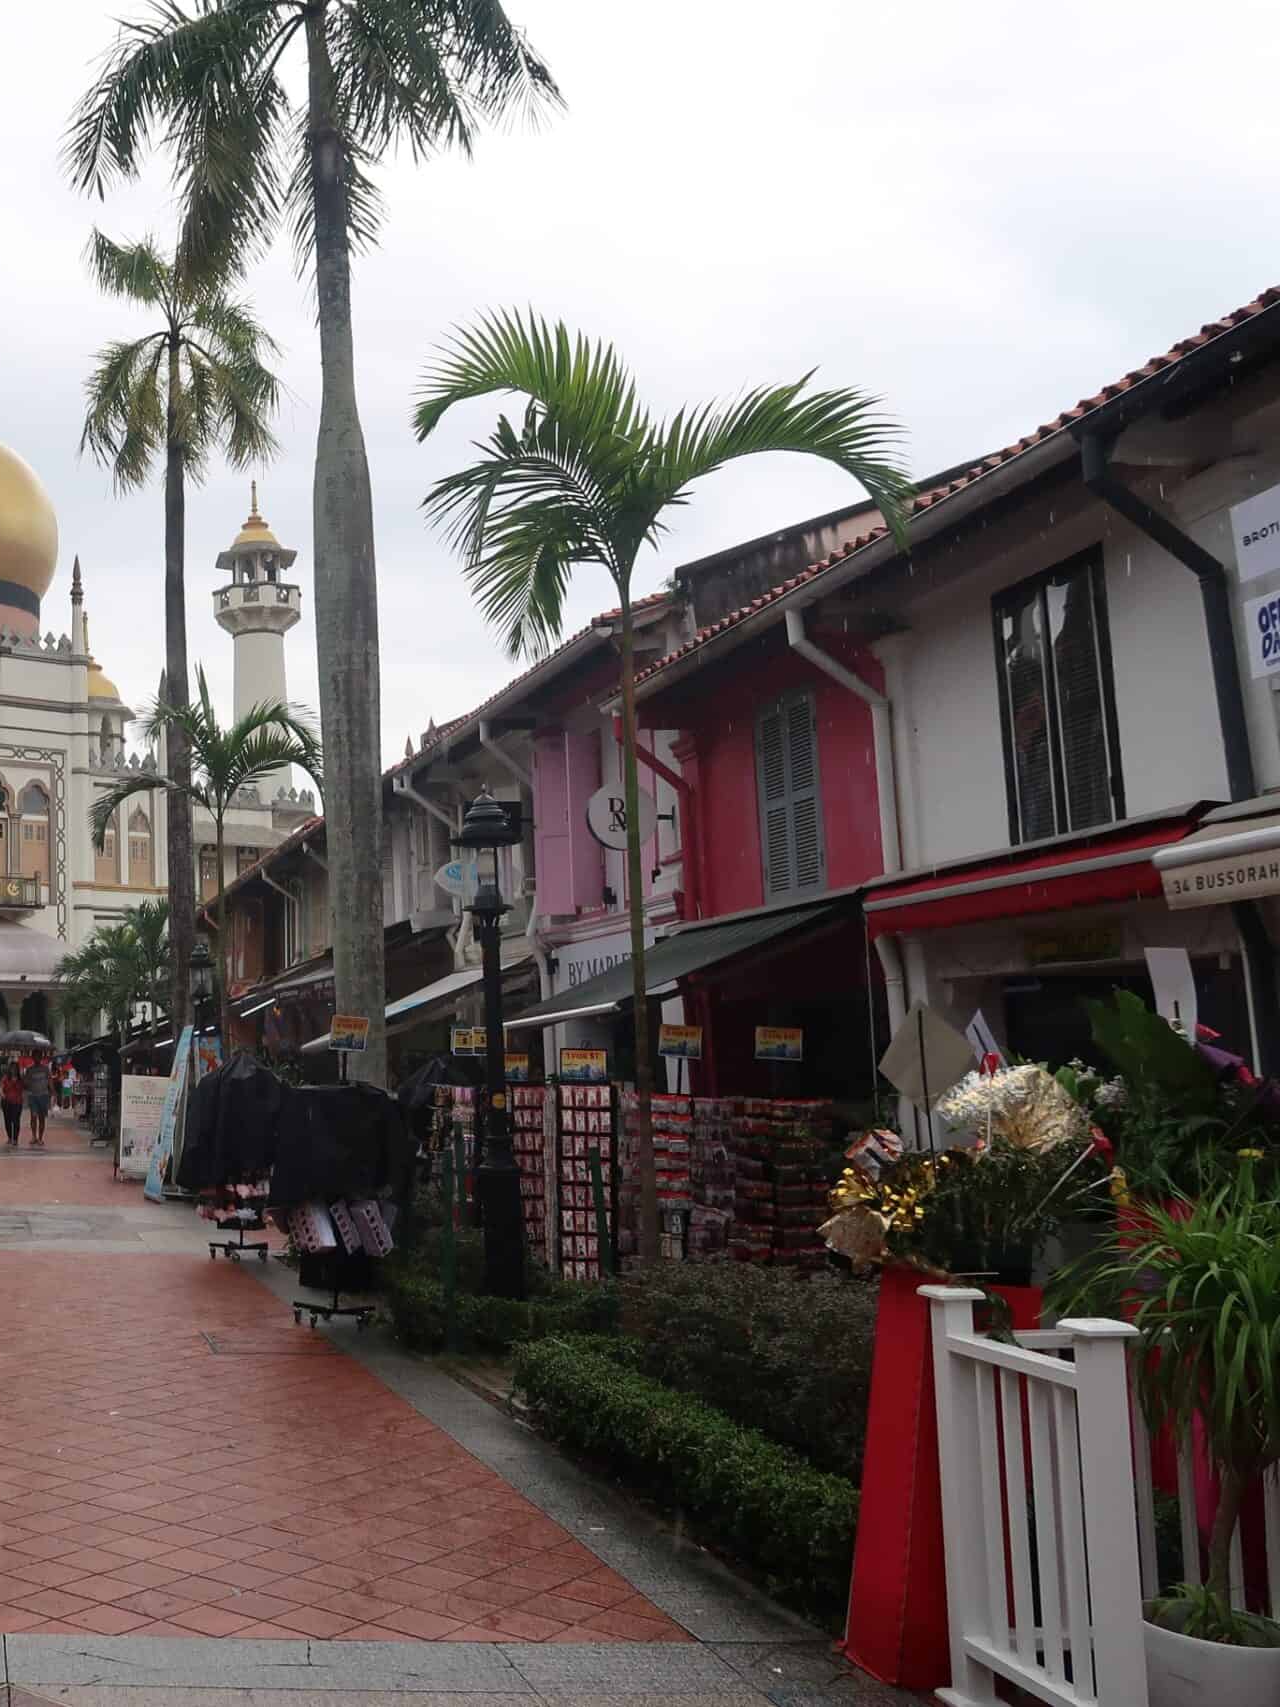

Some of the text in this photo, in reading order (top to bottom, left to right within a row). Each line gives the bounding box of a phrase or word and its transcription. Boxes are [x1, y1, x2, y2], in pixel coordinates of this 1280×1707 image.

[1258, 597, 1280, 633] OF
[1173, 863, 1279, 894] 34 BUSSORAH
[568, 960, 586, 986] BY
